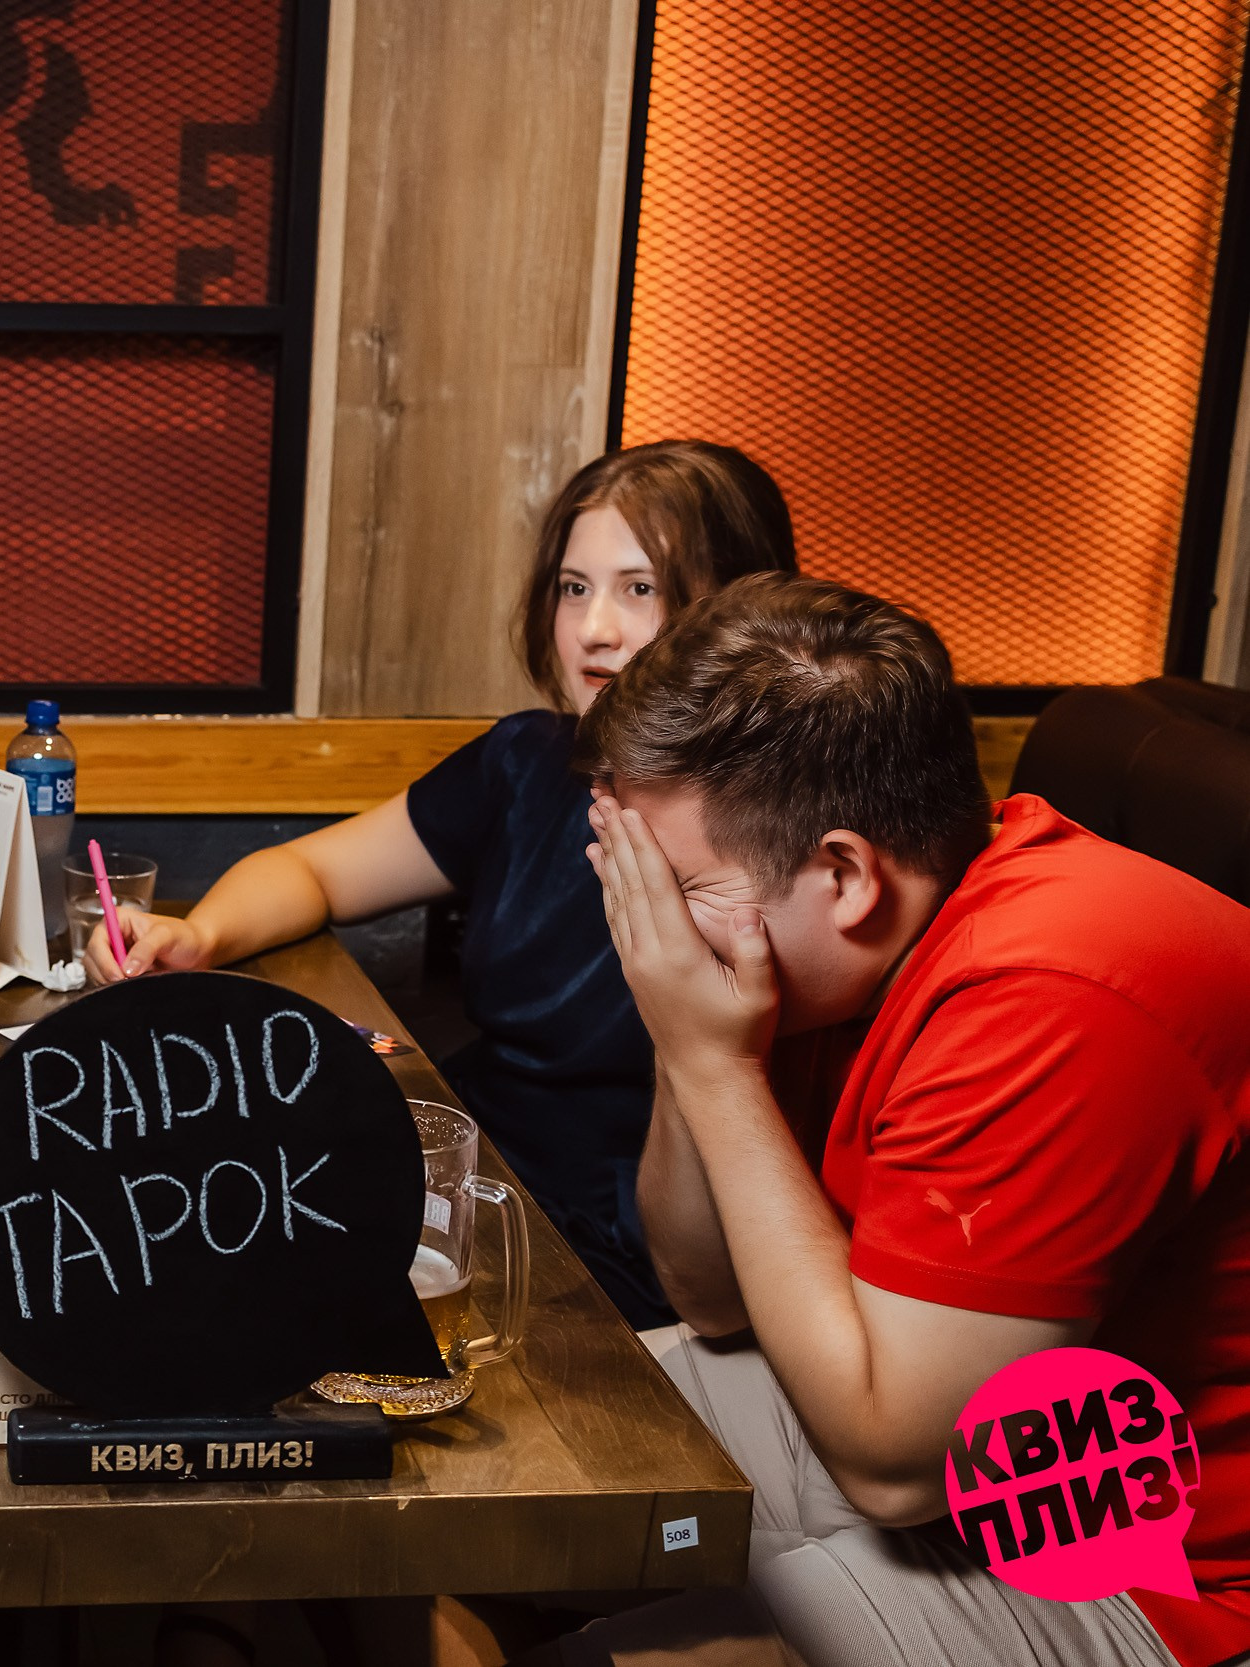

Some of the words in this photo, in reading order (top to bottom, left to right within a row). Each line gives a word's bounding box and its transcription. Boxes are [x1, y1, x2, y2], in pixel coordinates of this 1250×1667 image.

[22, 1010, 320, 1160] RADIO
[91, 1443, 194, 1476] КВИЗ,
[206, 1440, 314, 1469] ПЛИЗ!
[666, 1528, 691, 1544] 508
